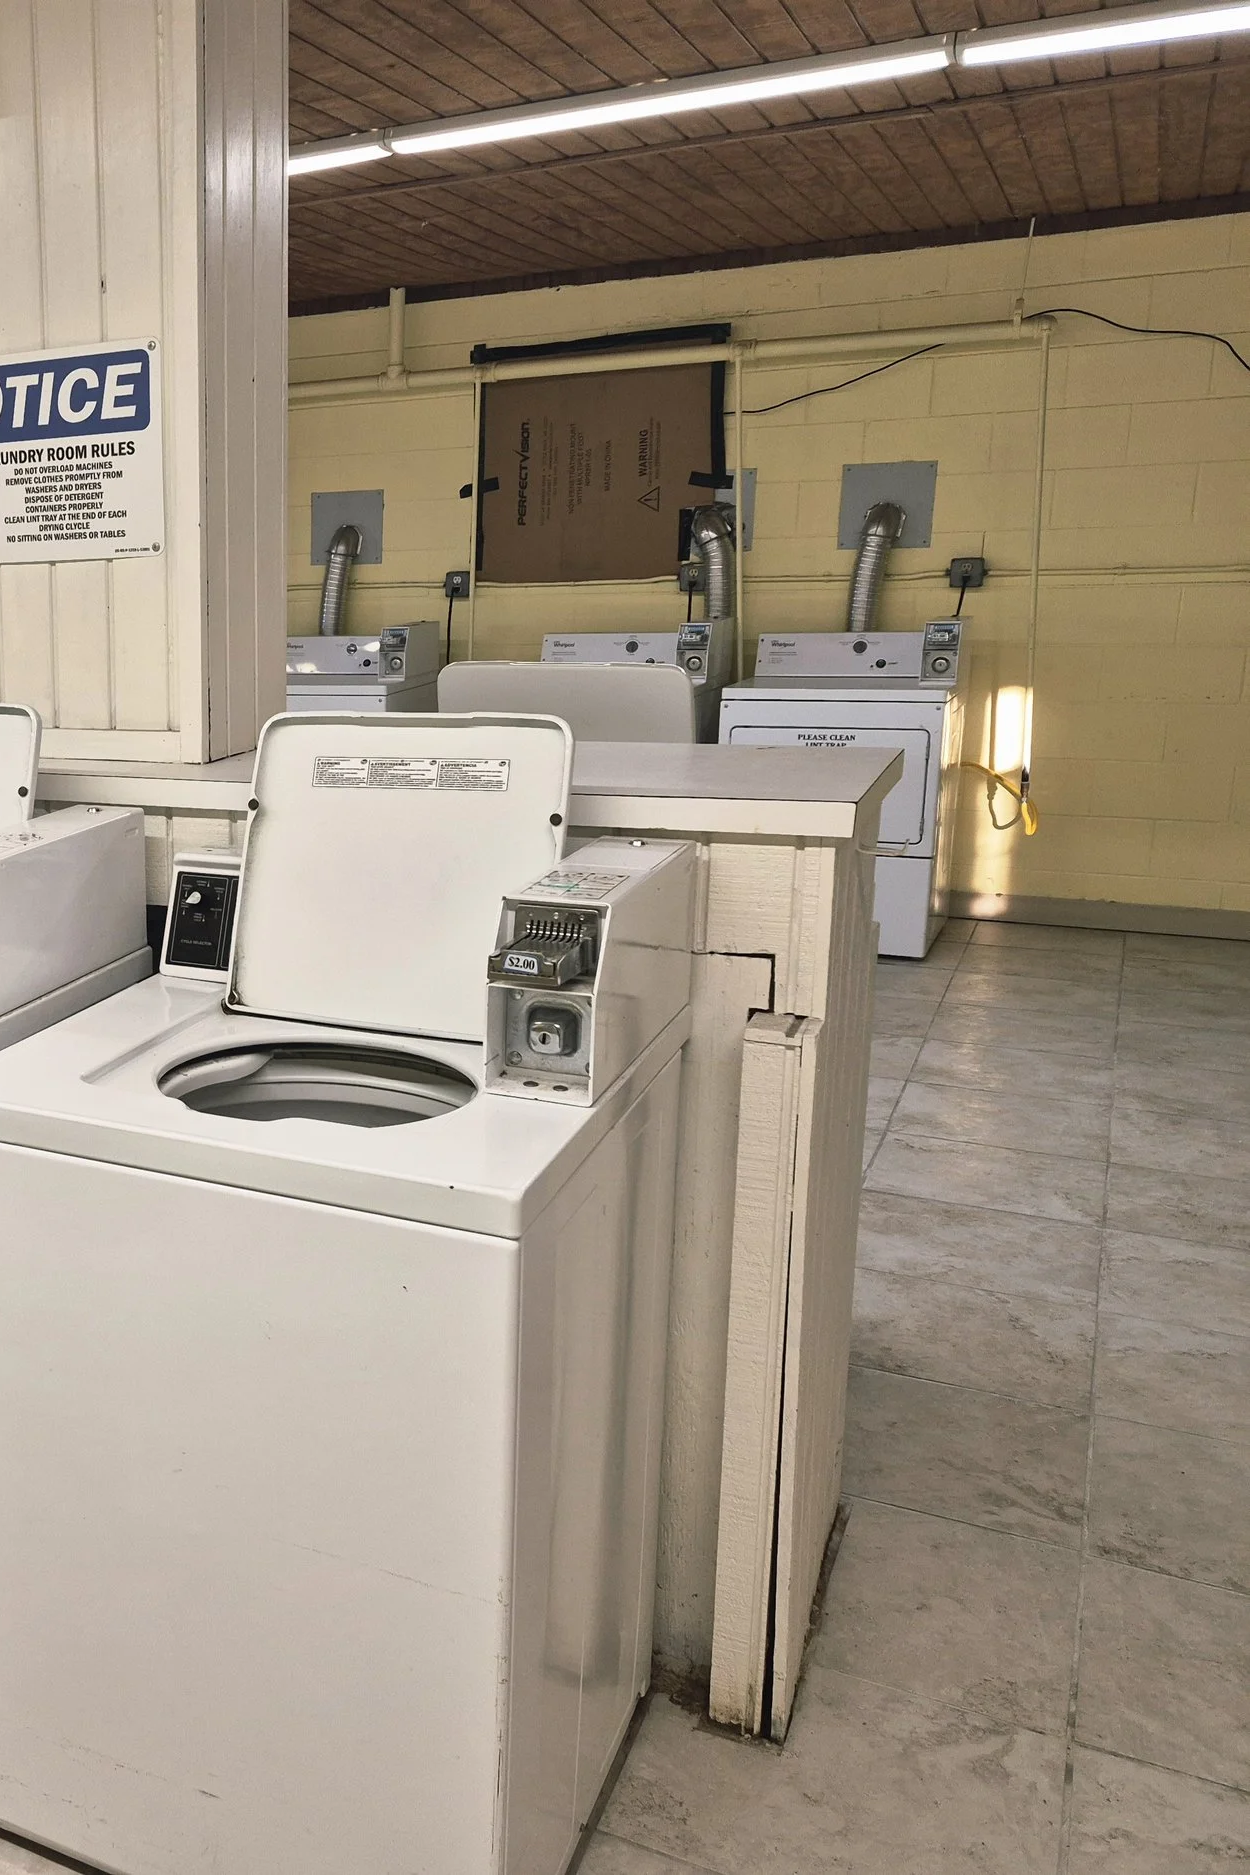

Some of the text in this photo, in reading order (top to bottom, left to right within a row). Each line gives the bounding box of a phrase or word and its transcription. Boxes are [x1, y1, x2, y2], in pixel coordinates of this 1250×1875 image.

[47, 445, 87, 462] ROOM
[92, 441, 135, 459] RULES
[638, 429, 649, 477] WARNING
[14, 461, 113, 476] DO NOT OVERLOAD MACHINES
[5, 470, 123, 486] REMOVE CLOTHES PROMPTLY FROM
[25, 482, 102, 494] WASHERS AND DRYERS
[24, 491, 104, 504] DISPOSE OF DETERGENT
[25, 501, 104, 514] CONTAINERS PROPERLY
[4, 510, 127, 524] CLEAN LINT TRAY AT THE END OF EACH
[39, 522, 90, 532] DRYING CLYCLE
[7, 530, 126, 543] NO SITTING ON WASHERS OR TABLES
[508, 956, 535, 970] $2.00
